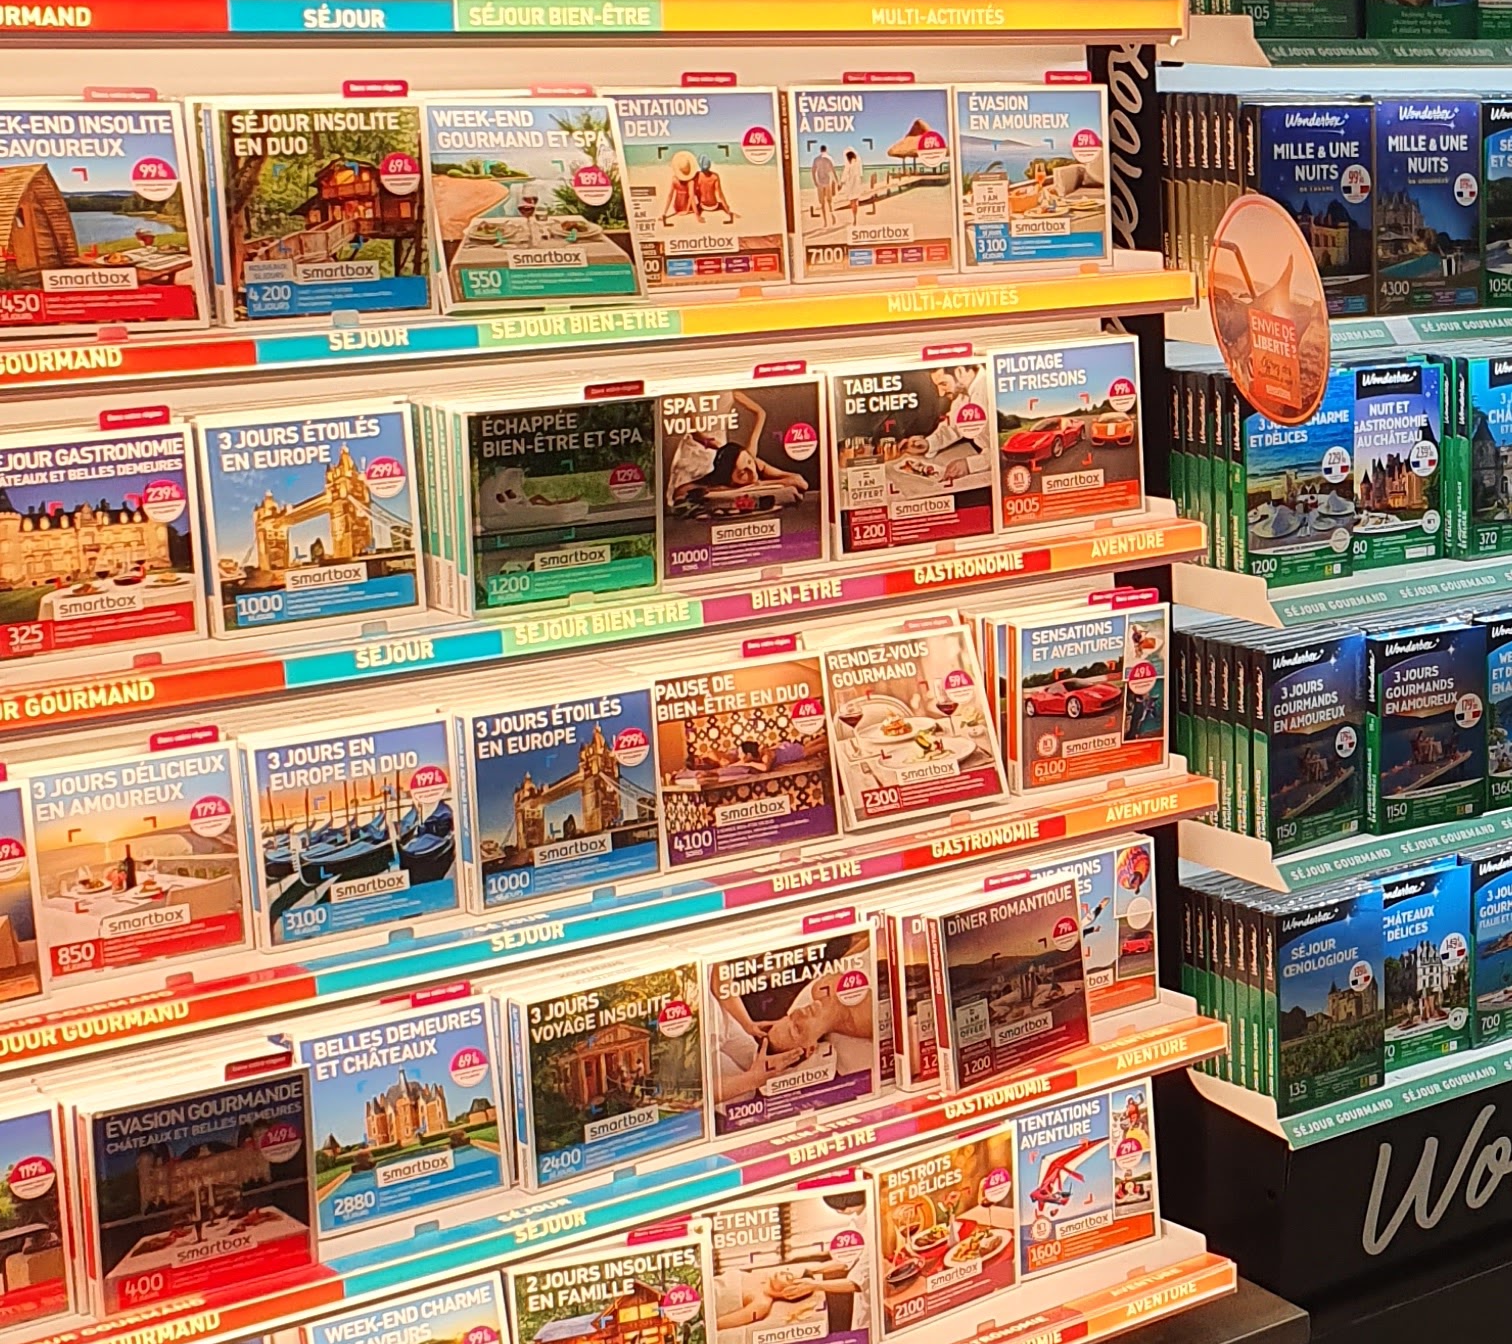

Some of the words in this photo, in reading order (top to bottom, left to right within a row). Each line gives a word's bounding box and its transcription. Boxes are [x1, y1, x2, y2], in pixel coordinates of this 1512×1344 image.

[303, 5, 385, 29] SÉJOUR
[469, 4, 544, 27] SÉJOUR
[550, 5, 651, 27] BIEN-ÊTRE
[871, 4, 1004, 27] MULTI-ACTIVITÉS
[968, 93, 1028, 113] ÉVASION
[231, 111, 309, 135] SÉJOUR
[314, 110, 400, 133] INSOLITE
[432, 109, 534, 130] WEEK-END
[970, 113, 990, 131] EN
[992, 110, 1070, 131] AMOUREUX
[234, 137, 265, 156] EN
[269, 136, 308, 156] DUO
[437, 130, 544, 150] GOURMAND
[548, 130, 569, 148] ET
[573, 131, 609, 149] SPA
[1273, 142, 1318, 160] MILLE
[1318, 144, 1326, 158] &
[1328, 141, 1360, 158] UNE
[1295, 163, 1339, 182] NUITS
[49, 269, 131, 288] smartbox
[1252, 316, 1280, 337] ENVIE
[1281, 325, 1295, 342] DE
[1252, 334, 1289, 356] LIBERTÉ
[997, 352, 1063, 375] PILOTAGE
[844, 375, 902, 396] TABLES
[998, 374, 1016, 392] ET
[1019, 368, 1087, 390] FRISSONS
[663, 397, 693, 416] SPA
[696, 395, 718, 412] ET
[845, 397, 868, 415] DE
[871, 392, 919, 413] CHEFS
[1369, 401, 1394, 417] NUIT
[1396, 401, 1409, 415] ET
[219, 432, 232, 450] 3
[235, 428, 300, 449] JOURS
[303, 418, 380, 443] ÉTOILÉS
[664, 408, 739, 434] VOLUPTÉ
[54, 437, 184, 465] GASTRONOMIE
[1375, 430, 1423, 447] CHÂTEAU
[222, 451, 250, 472] EN
[253, 446, 332, 469] EUROPE
[1090, 531, 1165, 559] AVENTURE
[913, 551, 1024, 584] GASTRONOMIE
[1031, 621, 1113, 646] SENSATIONS
[1051, 635, 1124, 658] AVENTURES
[827, 640, 929, 671] RENDEZ-VOUS
[655, 679, 709, 701] PAUSE
[713, 675, 736, 694] DE
[831, 662, 918, 689] GOURMAND
[1386, 677, 1454, 699] GOURMANDS
[657, 686, 747, 721] BIEN-ÊTRE
[750, 684, 771, 704] EN
[774, 681, 810, 701] DUO
[267, 752, 280, 769] 3
[282, 744, 342, 767] JOURS
[347, 737, 376, 758] EN
[33, 782, 45, 800] 3
[48, 771, 116, 798] JOURS
[121, 755, 225, 786] DÉLICIEUX
[270, 766, 345, 791] EUROPE
[348, 760, 375, 781] EN
[380, 751, 419, 773] DUO
[36, 799, 66, 821] EN
[70, 782, 184, 817] AMOUREUX
[947, 909, 989, 938] DÎNER
[991, 883, 1074, 926] ROMANTIQUE
[1291, 937, 1336, 961] SÉJOUR
[718, 947, 808, 982] BIEN-ÊTRE
[811, 943, 828, 962] ET
[1283, 947, 1359, 979] ŒNOLOGIQUE
[720, 978, 768, 1000] SOINS
[770, 955, 863, 991] RELAXANTS
[313, 1032, 384, 1062] BELLES
[386, 1008, 482, 1047] DEMEURES
[316, 1060, 340, 1082] ET
[343, 1037, 439, 1076] CHÂTEAUX
[105, 1106, 186, 1141] ÉVASION
[188, 1082, 303, 1121] GOURMANDE
[1019, 1101, 1101, 1131] TENTATIONS
[1020, 1119, 1092, 1150] AVENTURE
[888, 1156, 953, 1185] BISTROTS
[908, 1169, 963, 1200] DÉLICES
[324, 1311, 419, 1344] WEEK-END
[422, 1286, 493, 1319] CHARME
